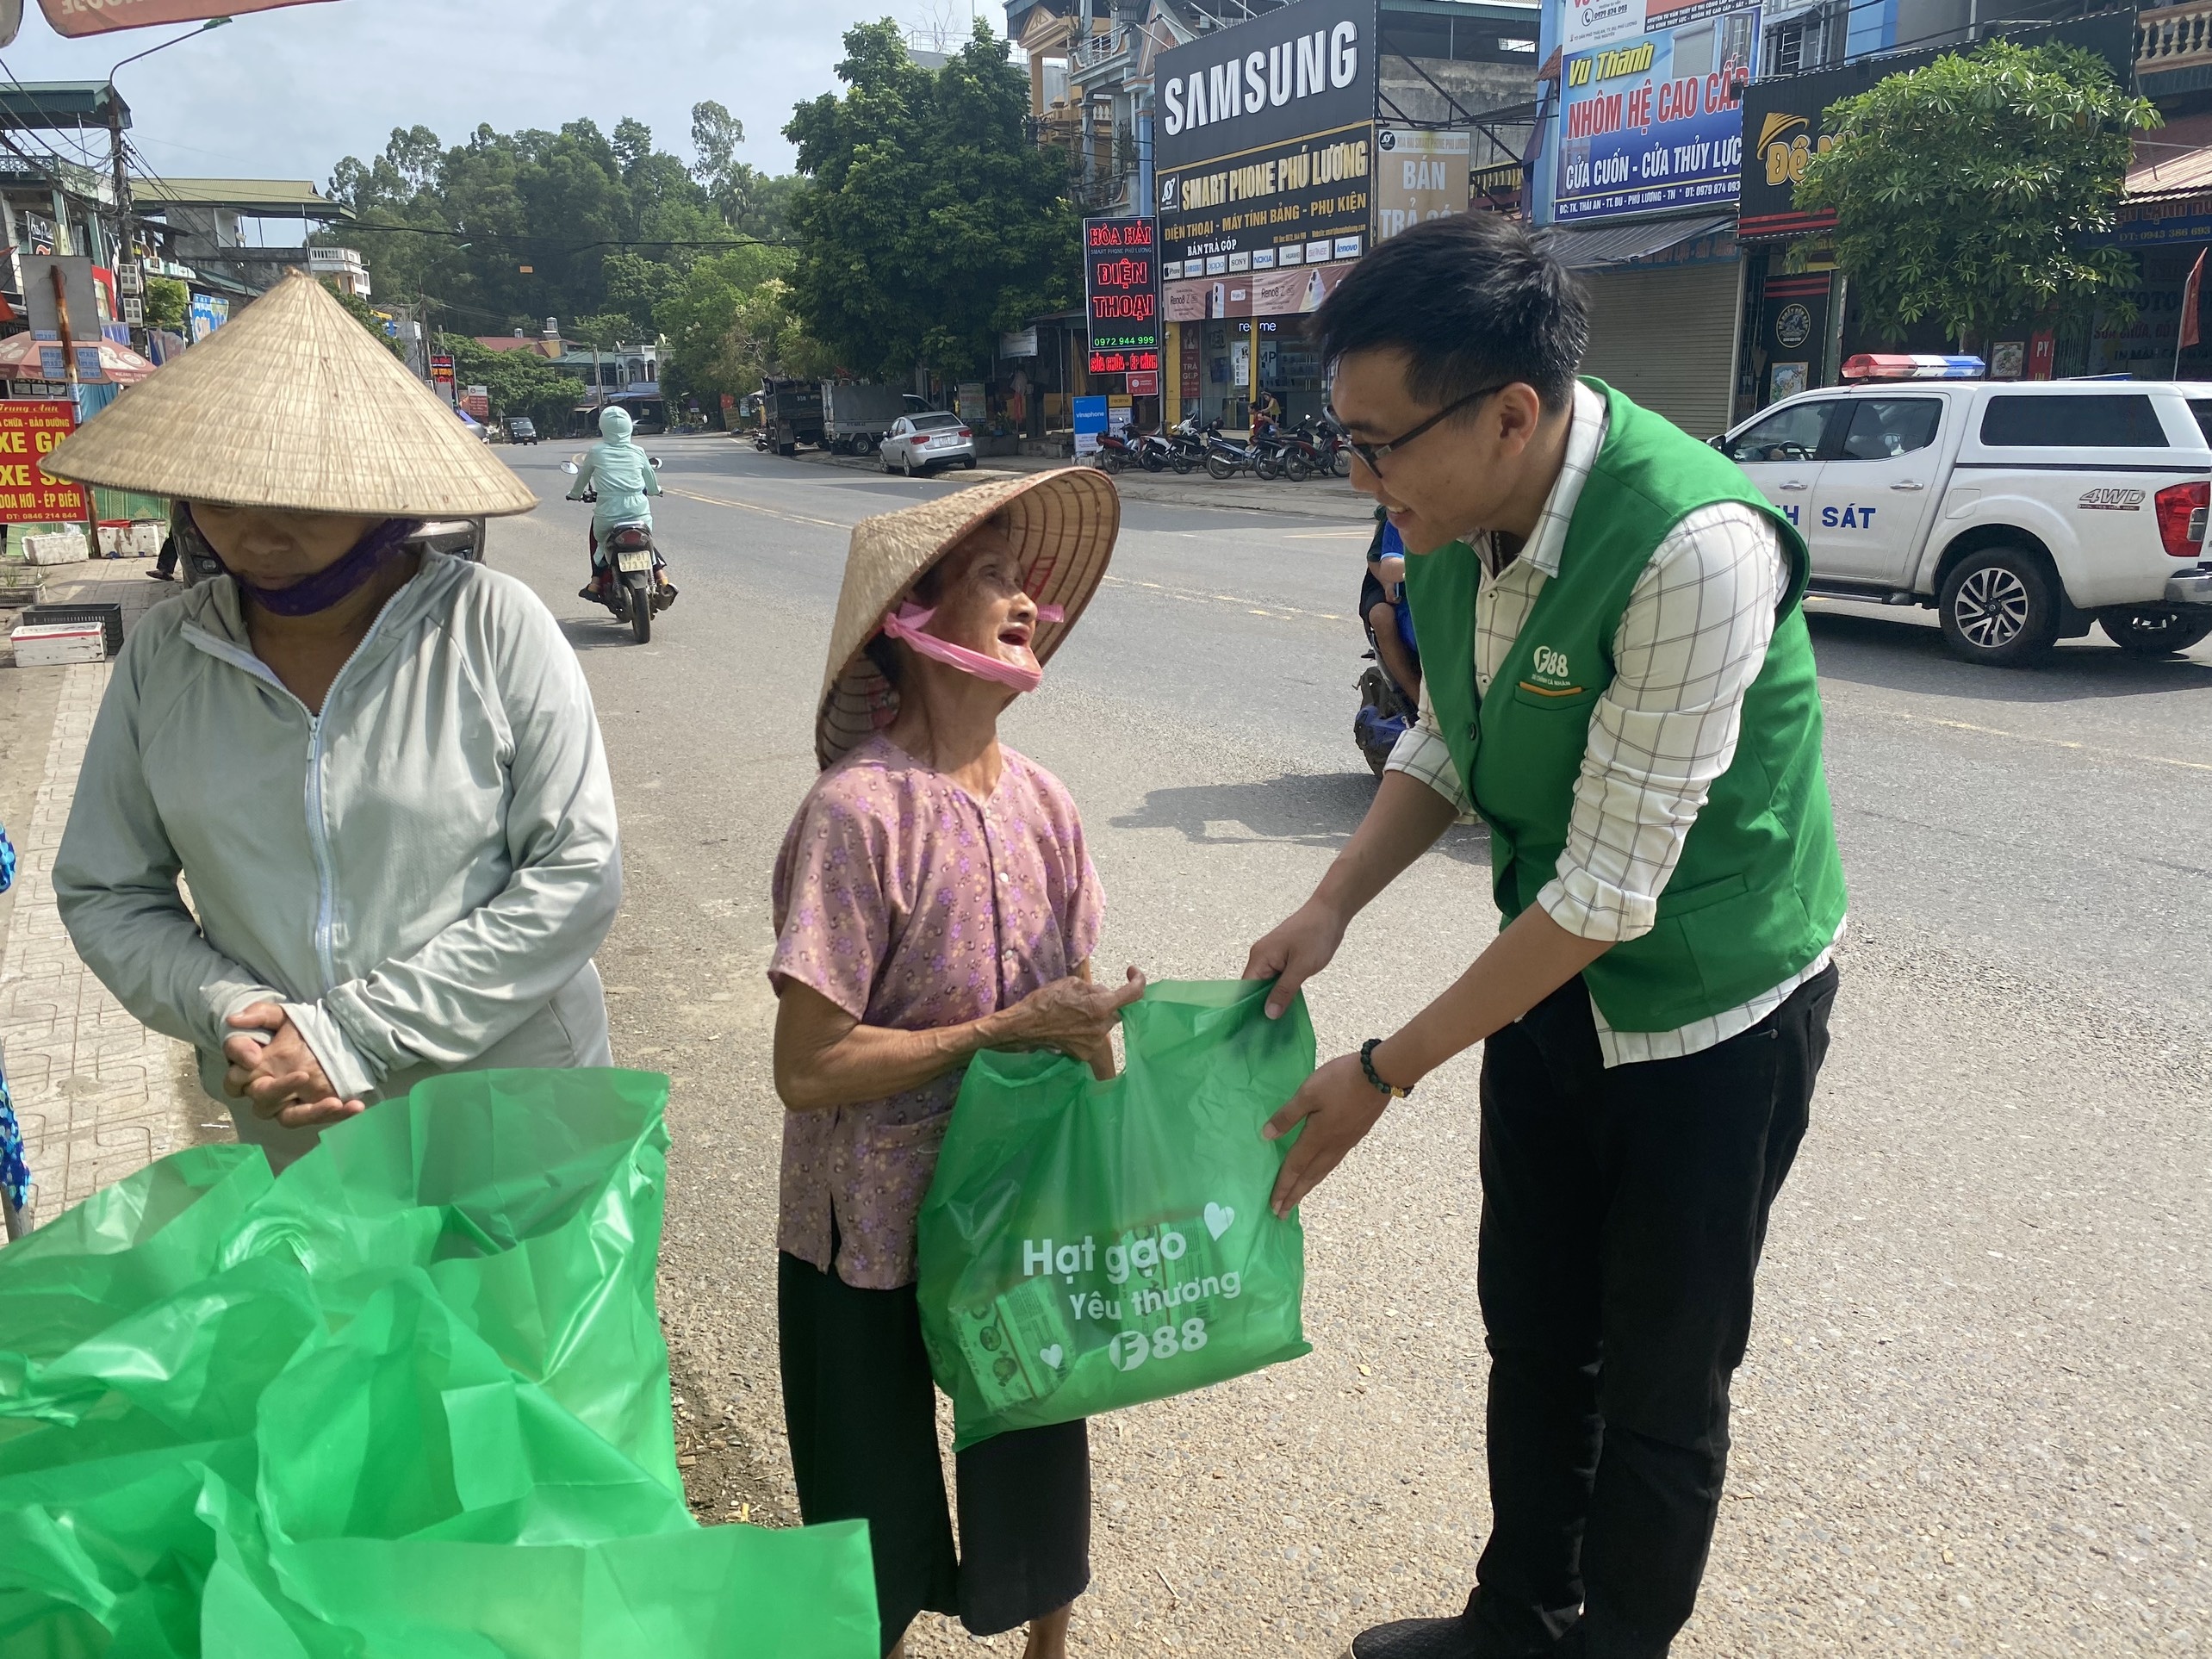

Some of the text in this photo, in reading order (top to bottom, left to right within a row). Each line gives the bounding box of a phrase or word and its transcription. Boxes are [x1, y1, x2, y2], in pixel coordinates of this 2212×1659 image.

[1569, 41, 1655, 87] Vũ Thành
[1164, 21, 1358, 136] SAMSUNG
[1567, 89, 1623, 140] NHÔM
[1626, 78, 1653, 136] HỆ
[1657, 77, 1699, 123] CAO
[1402, 155, 1445, 190] BÁN
[1565, 156, 1590, 190] CỬA
[1594, 146, 1630, 186] CUỐN
[1642, 142, 1669, 179] CỬA
[1674, 135, 1710, 174] THỦY
[1712, 136, 1742, 173] LỰC
[1182, 140, 1368, 212] SMART PHONE PHÚ LƯƠNG
[1592, 199, 1601, 209] AN
[1628, 192, 1641, 205] PHÚ
[1641, 190, 1662, 203] LƯƠNG
[1668, 190, 1675, 200] TN
[1696, 183, 1712, 196] 0979
[1713, 182, 1726, 194] 874
[1727, 181, 1741, 192] 093
[1165, 192, 1367, 242] ĐIỆN THOẠI MÁY TÍNH BẢNG PHỤ KIỆN
[1187, 240, 1202, 257] BÁN
[1221, 238, 1237, 251] GÓP
[1253, 254, 1273, 264] NOKIA
[1336, 243, 1358, 253] lenovo
[1097, 258, 1147, 289] ĐIỆN
[1231, 258, 1246, 267] SONY
[1170, 294, 1185, 305] Reno8
[1261, 286, 1279, 299] Reno8
[1093, 294, 1154, 321] THOẠI
[1094, 336, 1154, 346] 0972 944 999
[1130, 353, 1140, 370] ÉP
[3, 418, 23, 427] CHỮA
[0, 432, 28, 453] XE
[0, 465, 32, 487] XE
[19, 492, 36, 509] HƠI
[44, 490, 56, 508] ÉP
[59, 489, 81, 508] BIÊN
[2079, 488, 2146, 505] 4WD
[1822, 503, 1876, 529] SÁT
[1533, 645, 1569, 677] F88
[1023, 1232, 1187, 1284] Hạt gạo
[1069, 1271, 1242, 1320] Yêu thương
[1109, 1318, 1208, 1371] F88
